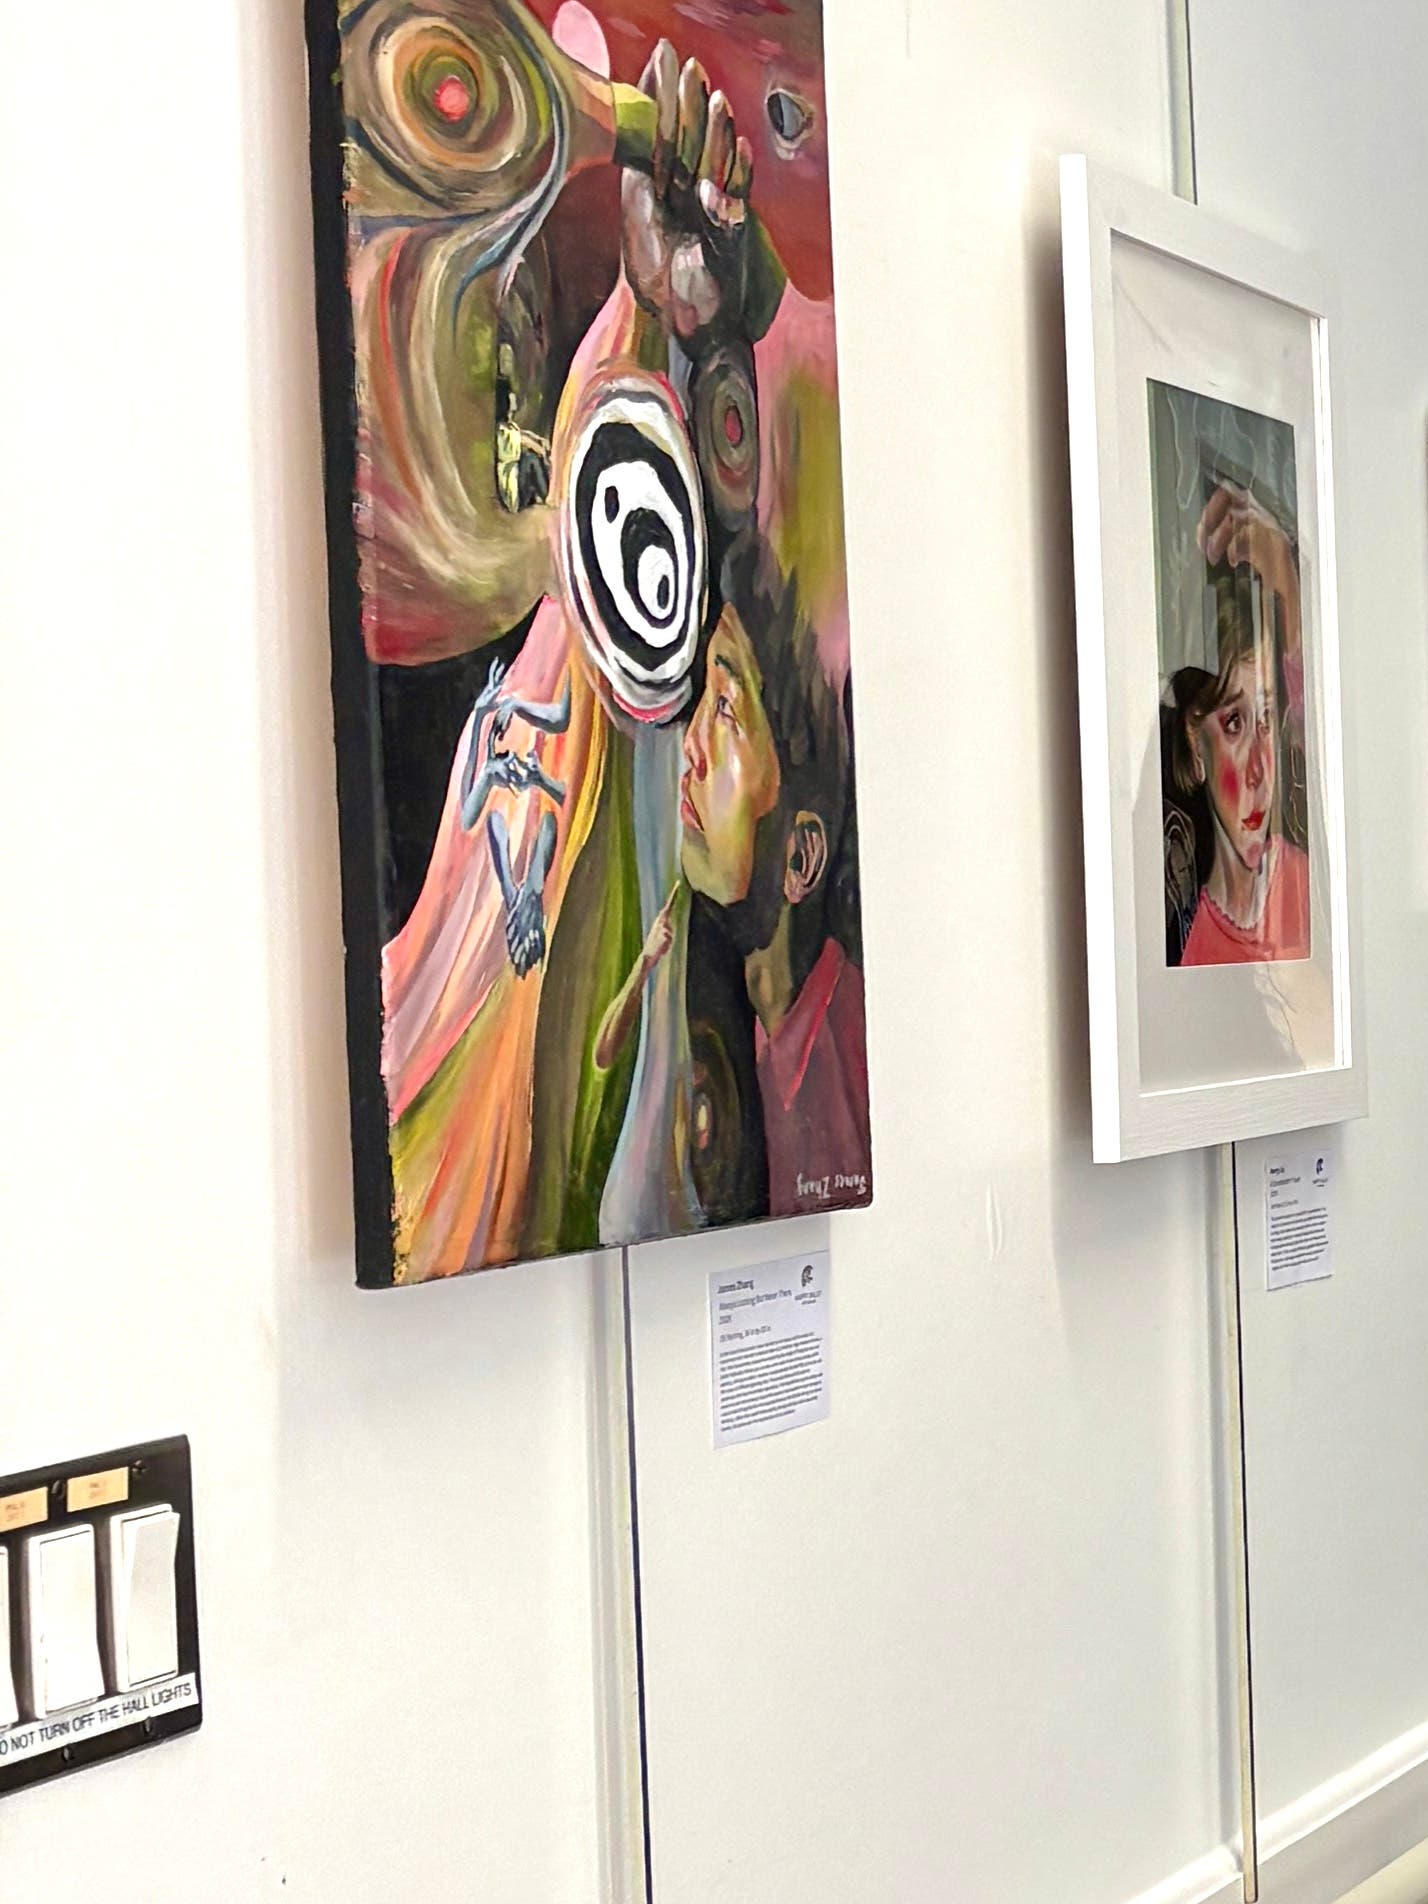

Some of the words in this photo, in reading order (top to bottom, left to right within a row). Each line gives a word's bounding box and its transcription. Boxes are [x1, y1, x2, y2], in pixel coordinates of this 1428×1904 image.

[0, 1739, 8, 1756] O
[11, 1733, 35, 1750] NOT
[39, 1722, 70, 1741] TURN
[73, 1713, 95, 1731] OFF
[97, 1704, 120, 1723] THE
[122, 1696, 149, 1714] HALL
[152, 1683, 192, 1704] LIGHTS
